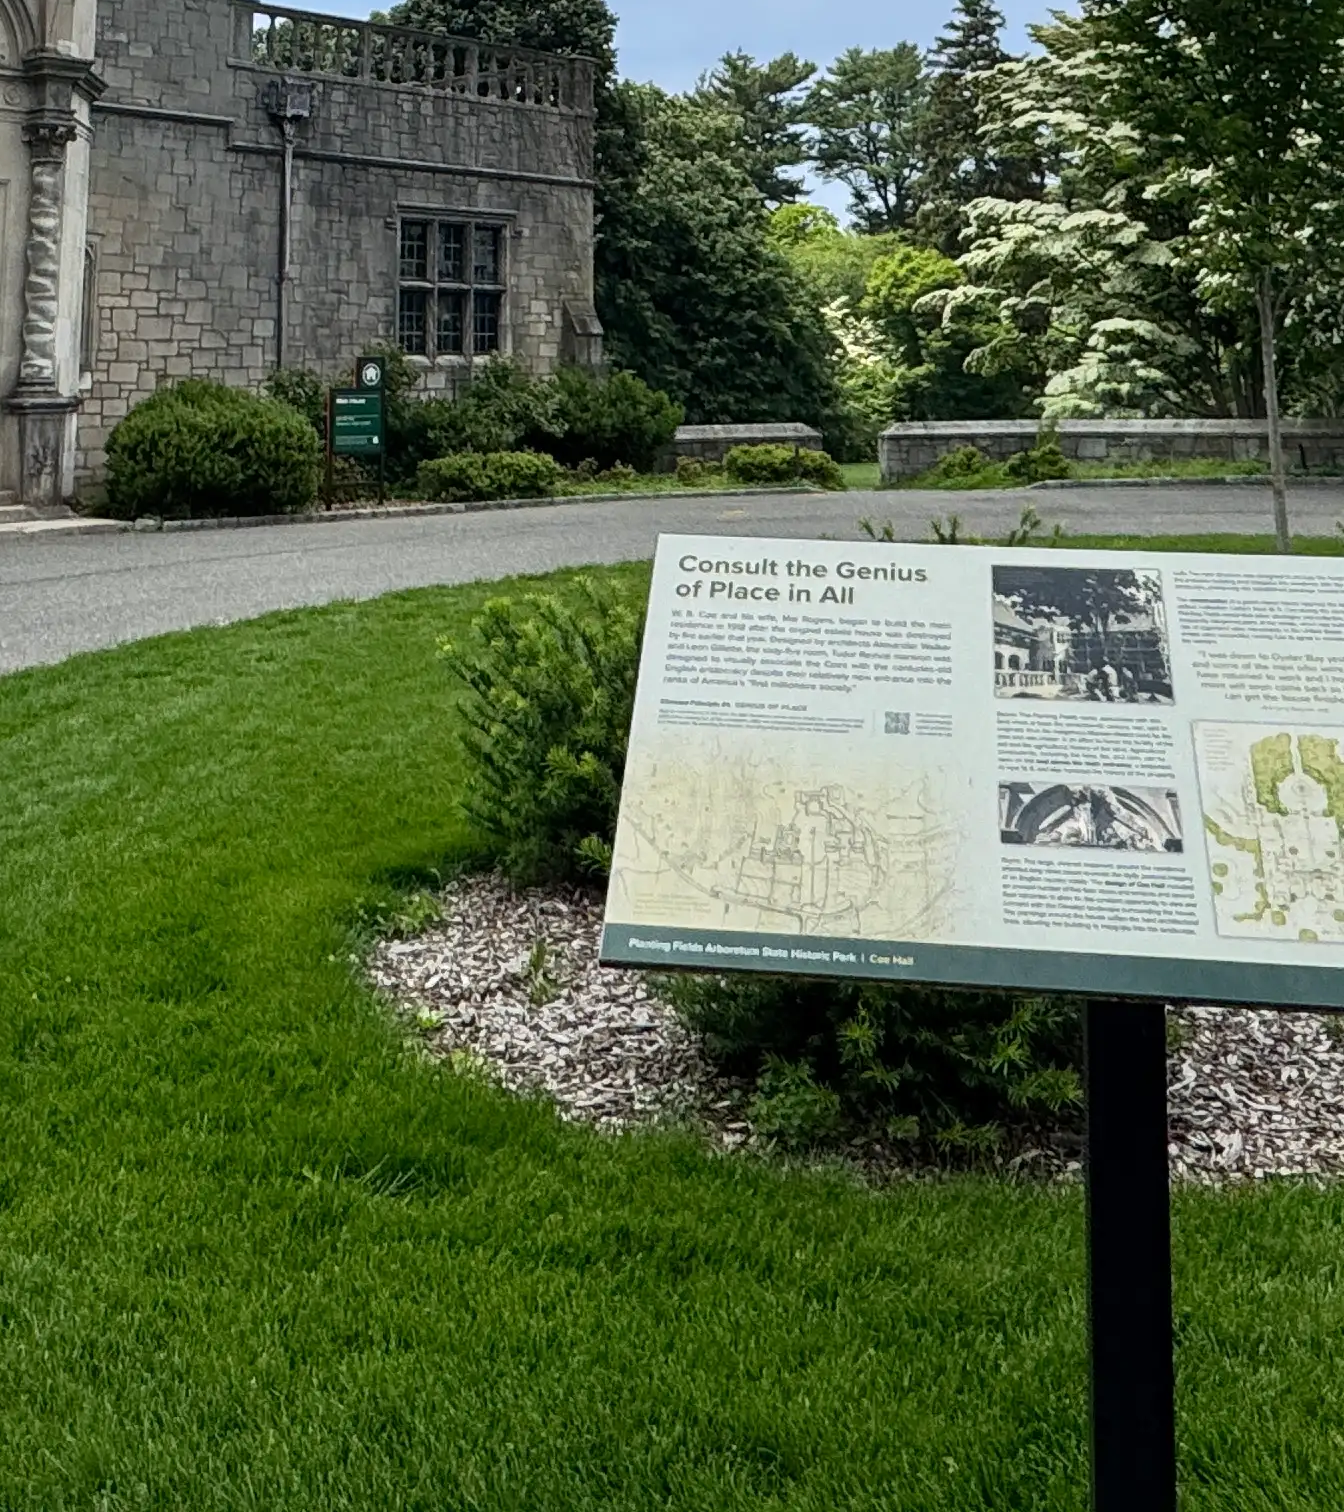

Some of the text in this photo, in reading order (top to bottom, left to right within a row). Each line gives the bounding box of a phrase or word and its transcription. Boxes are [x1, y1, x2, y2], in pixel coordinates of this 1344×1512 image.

[679, 555, 927, 581] Consult the Genius
[676, 580, 854, 604] of Place in All
[628, 937, 856, 963] Planting Fields Arboretum State Historic Park
[869, 953, 913, 966] Coe Hall
